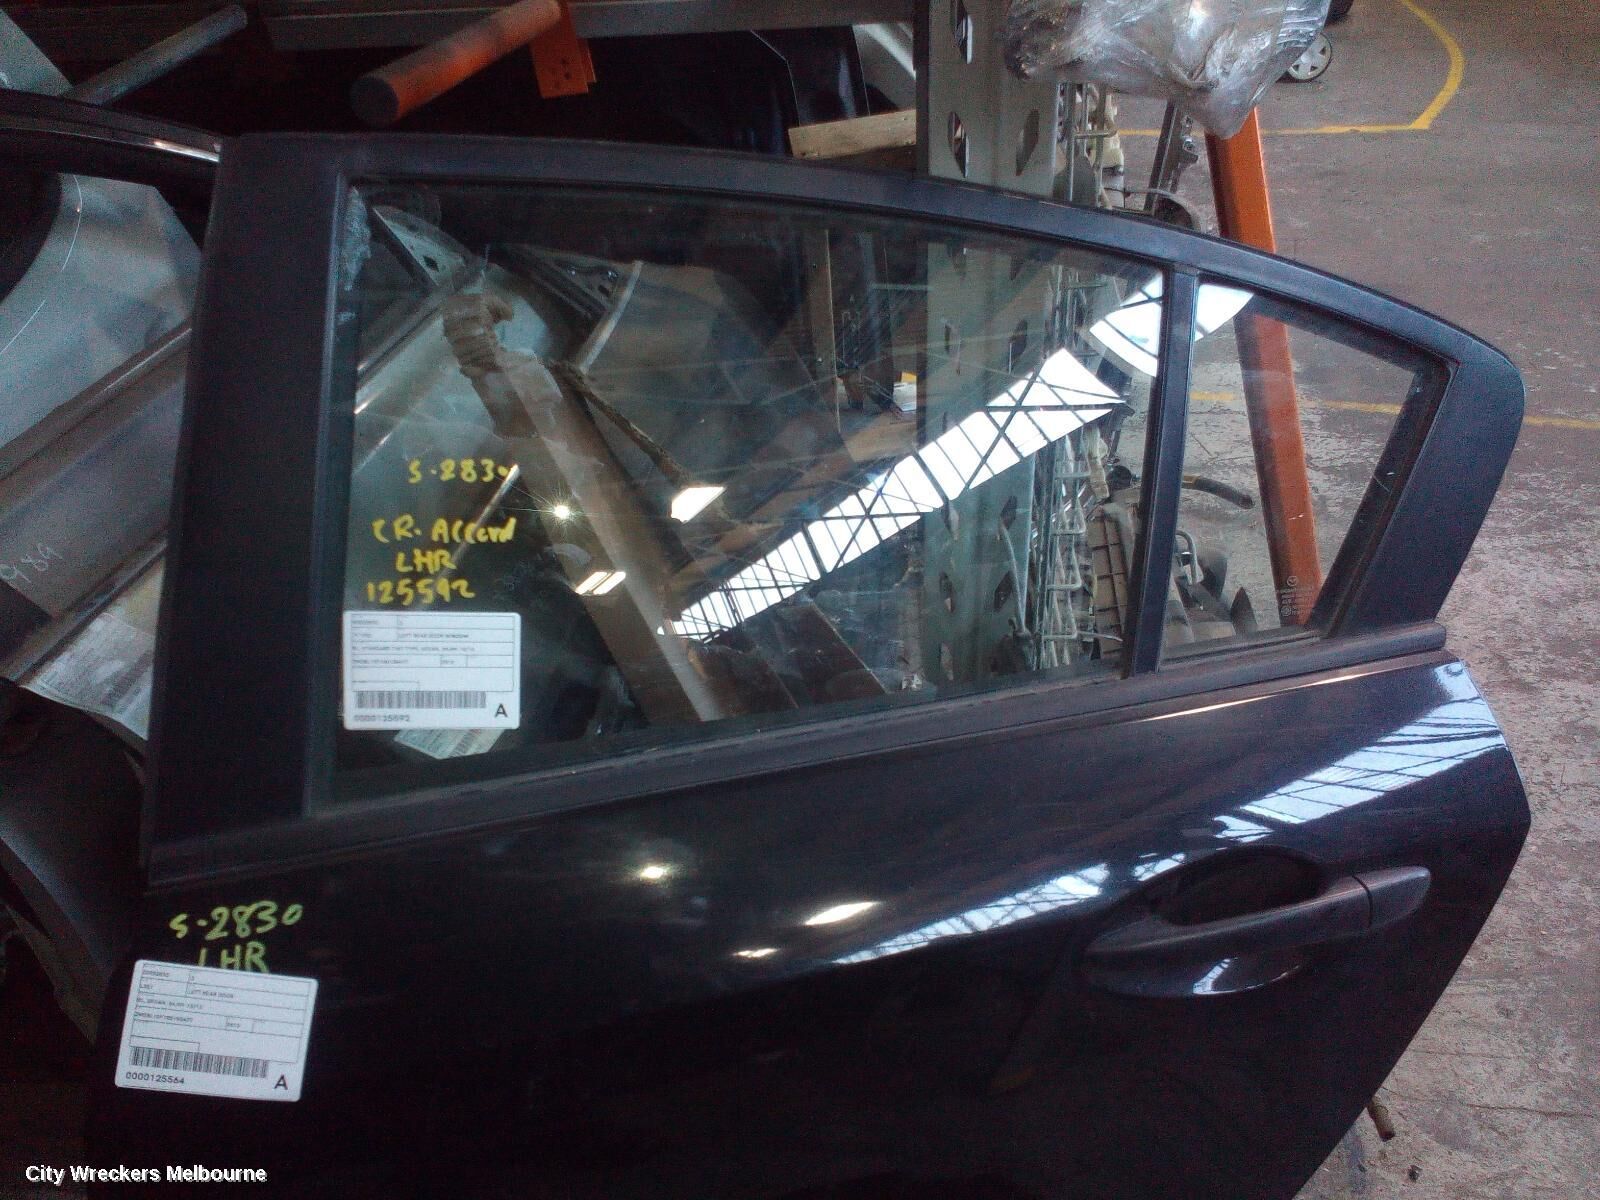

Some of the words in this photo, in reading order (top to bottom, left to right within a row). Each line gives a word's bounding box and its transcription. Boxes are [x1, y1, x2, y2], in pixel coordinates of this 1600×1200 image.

[396, 548, 457, 575] LHR
[494, 703, 508, 718] A
[125, 1071, 186, 1085] 0000125564
[274, 1074, 289, 1091] A
